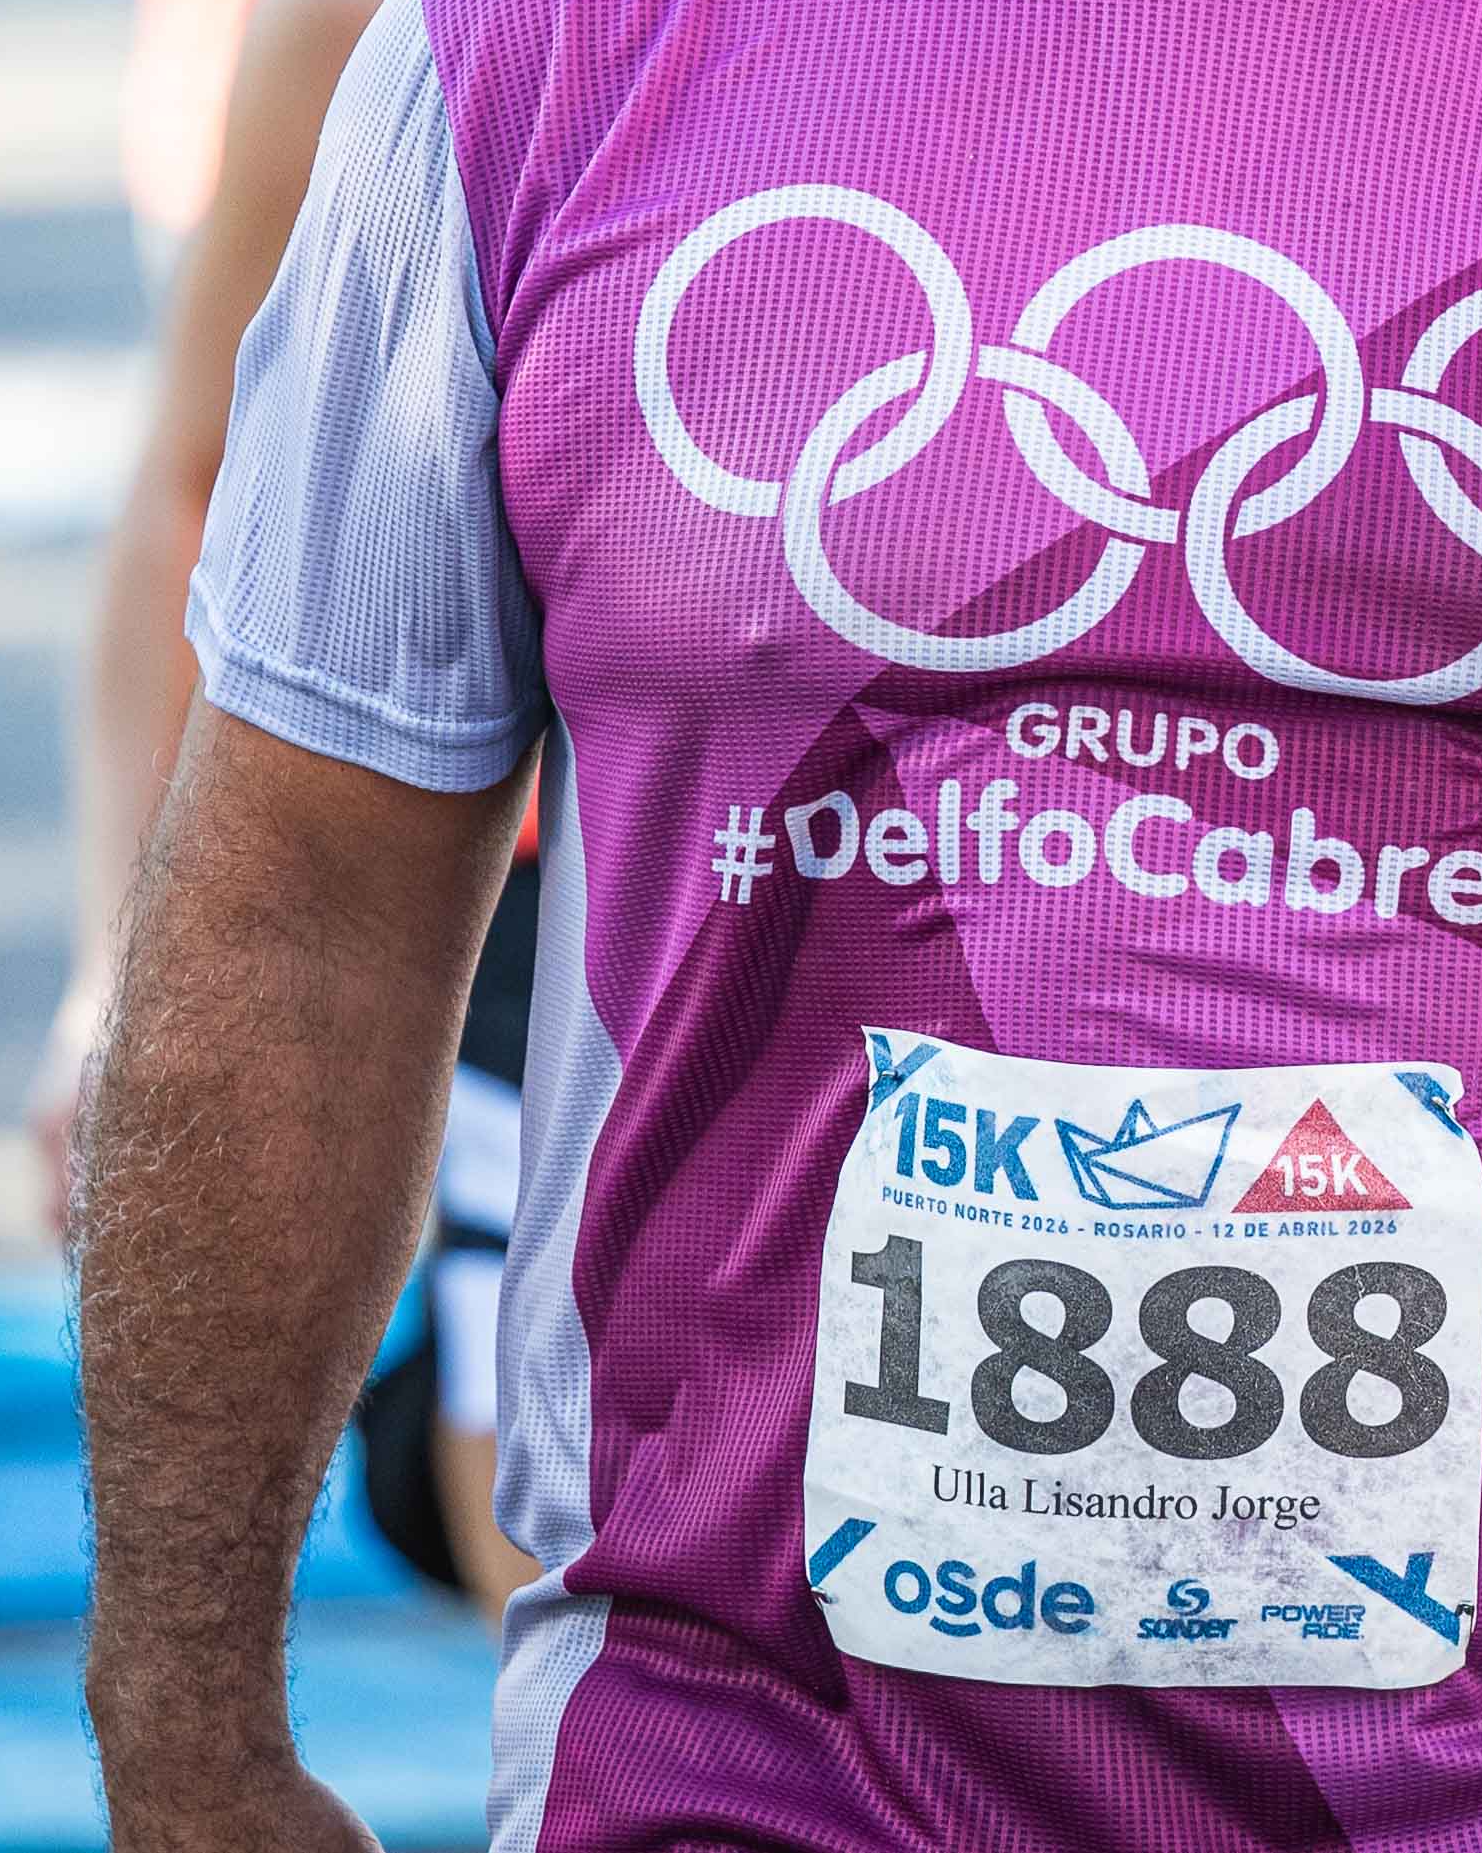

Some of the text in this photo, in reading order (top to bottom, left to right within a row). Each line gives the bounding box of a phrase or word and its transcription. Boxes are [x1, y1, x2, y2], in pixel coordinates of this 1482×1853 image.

[1005, 701, 1280, 780] GRUPO
[894, 1091, 1041, 1201] 15K
[1275, 1153, 1369, 1198] 15K
[882, 1185, 948, 1215] PUERTO
[954, 1203, 1014, 1228] NORTE
[1021, 1215, 1069, 1235] 2026
[1094, 1222, 1186, 1239] ROSARIO
[1212, 1223, 1234, 1238] 12
[1244, 1222, 1269, 1238] DE
[1278, 1220, 1339, 1237] ABRIL
[1348, 1219, 1398, 1235] 2026
[843, 1234, 1450, 1461] 1888
[932, 1464, 1321, 1530] Ulla Lisandro Jorge
[884, 1559, 1095, 1636] osde
[1261, 1604, 1366, 1622] POWER
